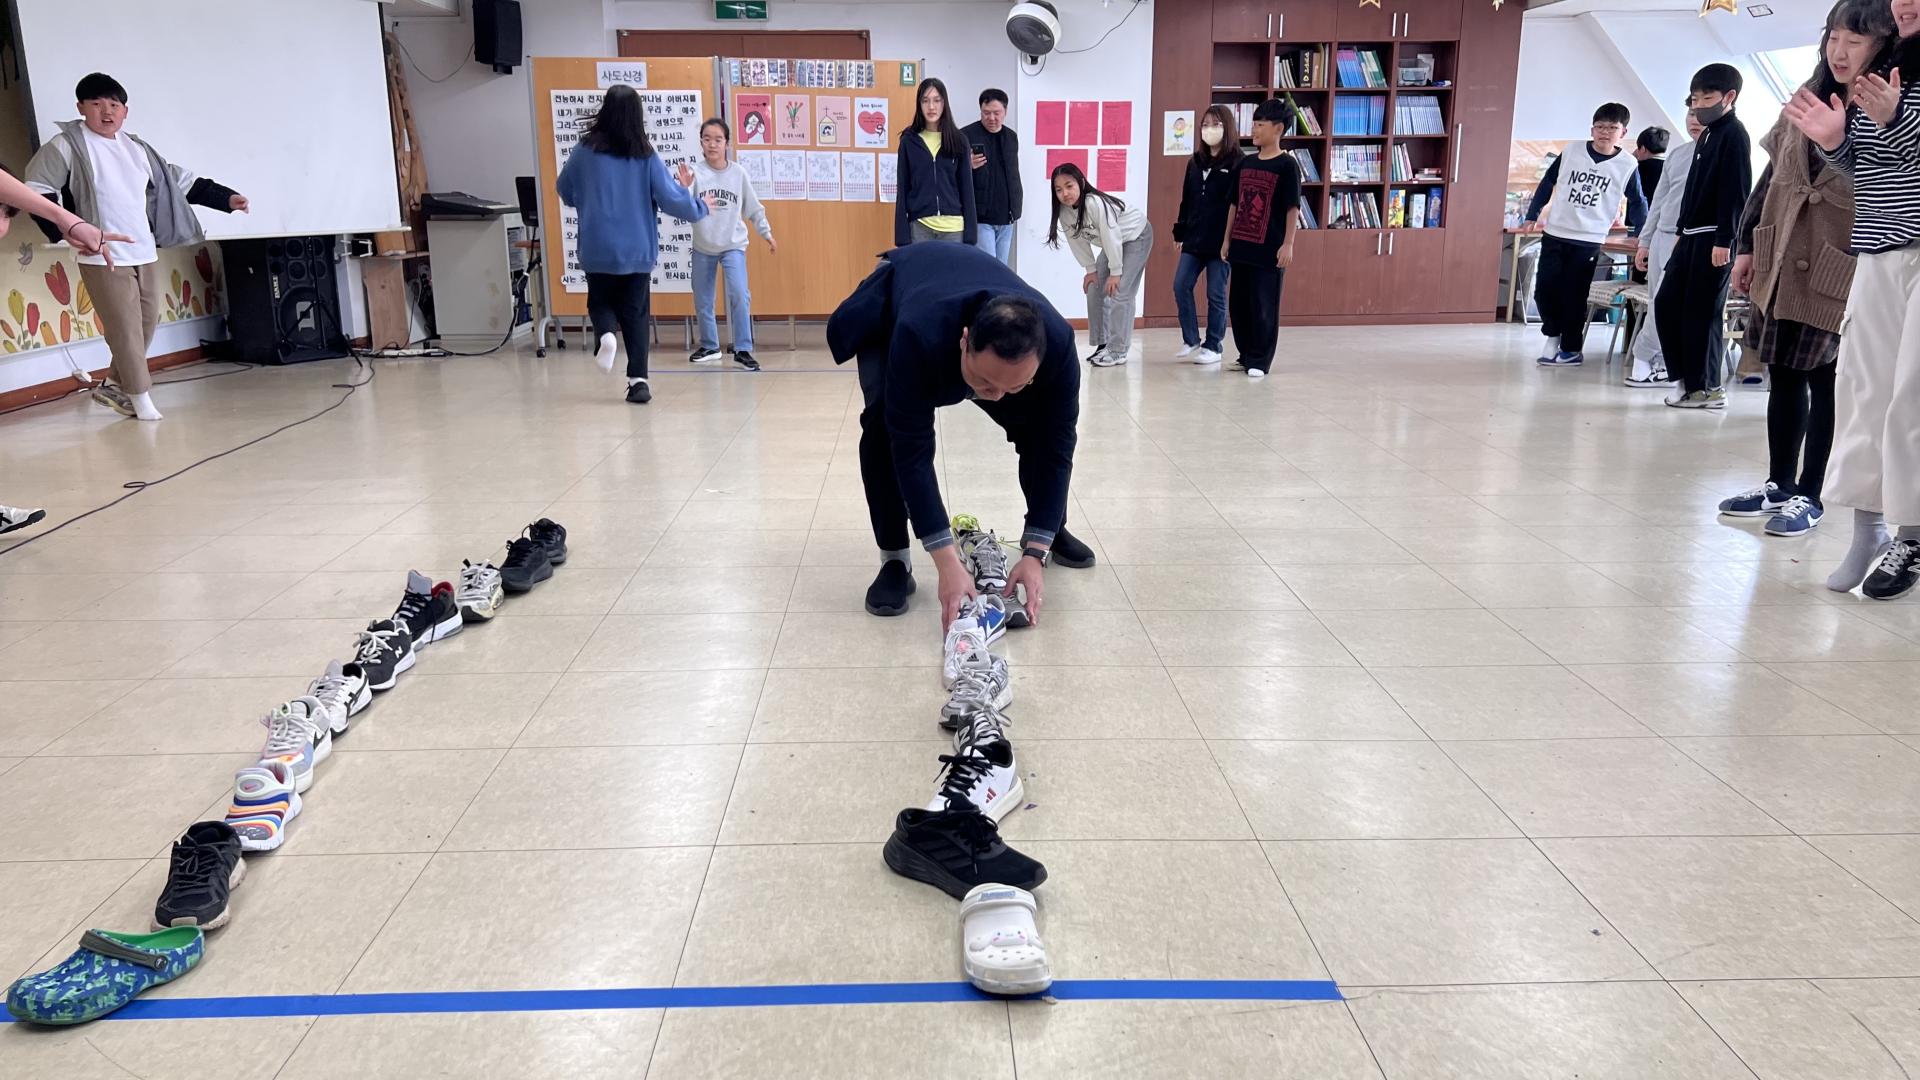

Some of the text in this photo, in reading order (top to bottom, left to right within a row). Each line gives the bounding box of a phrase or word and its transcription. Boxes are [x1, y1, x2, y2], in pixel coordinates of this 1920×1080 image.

[601, 70, 642, 82] 사도신경
[555, 94, 584, 104] 전능하사
[667, 94, 696, 103] 아버지를
[557, 108, 572, 116] 내가
[647, 105, 662, 114] 우리
[665, 105, 672, 113] 주
[1568, 170, 1611, 193] NORTH
[1568, 188, 1600, 206] FACE
[670, 233, 692, 242] 거룩한
